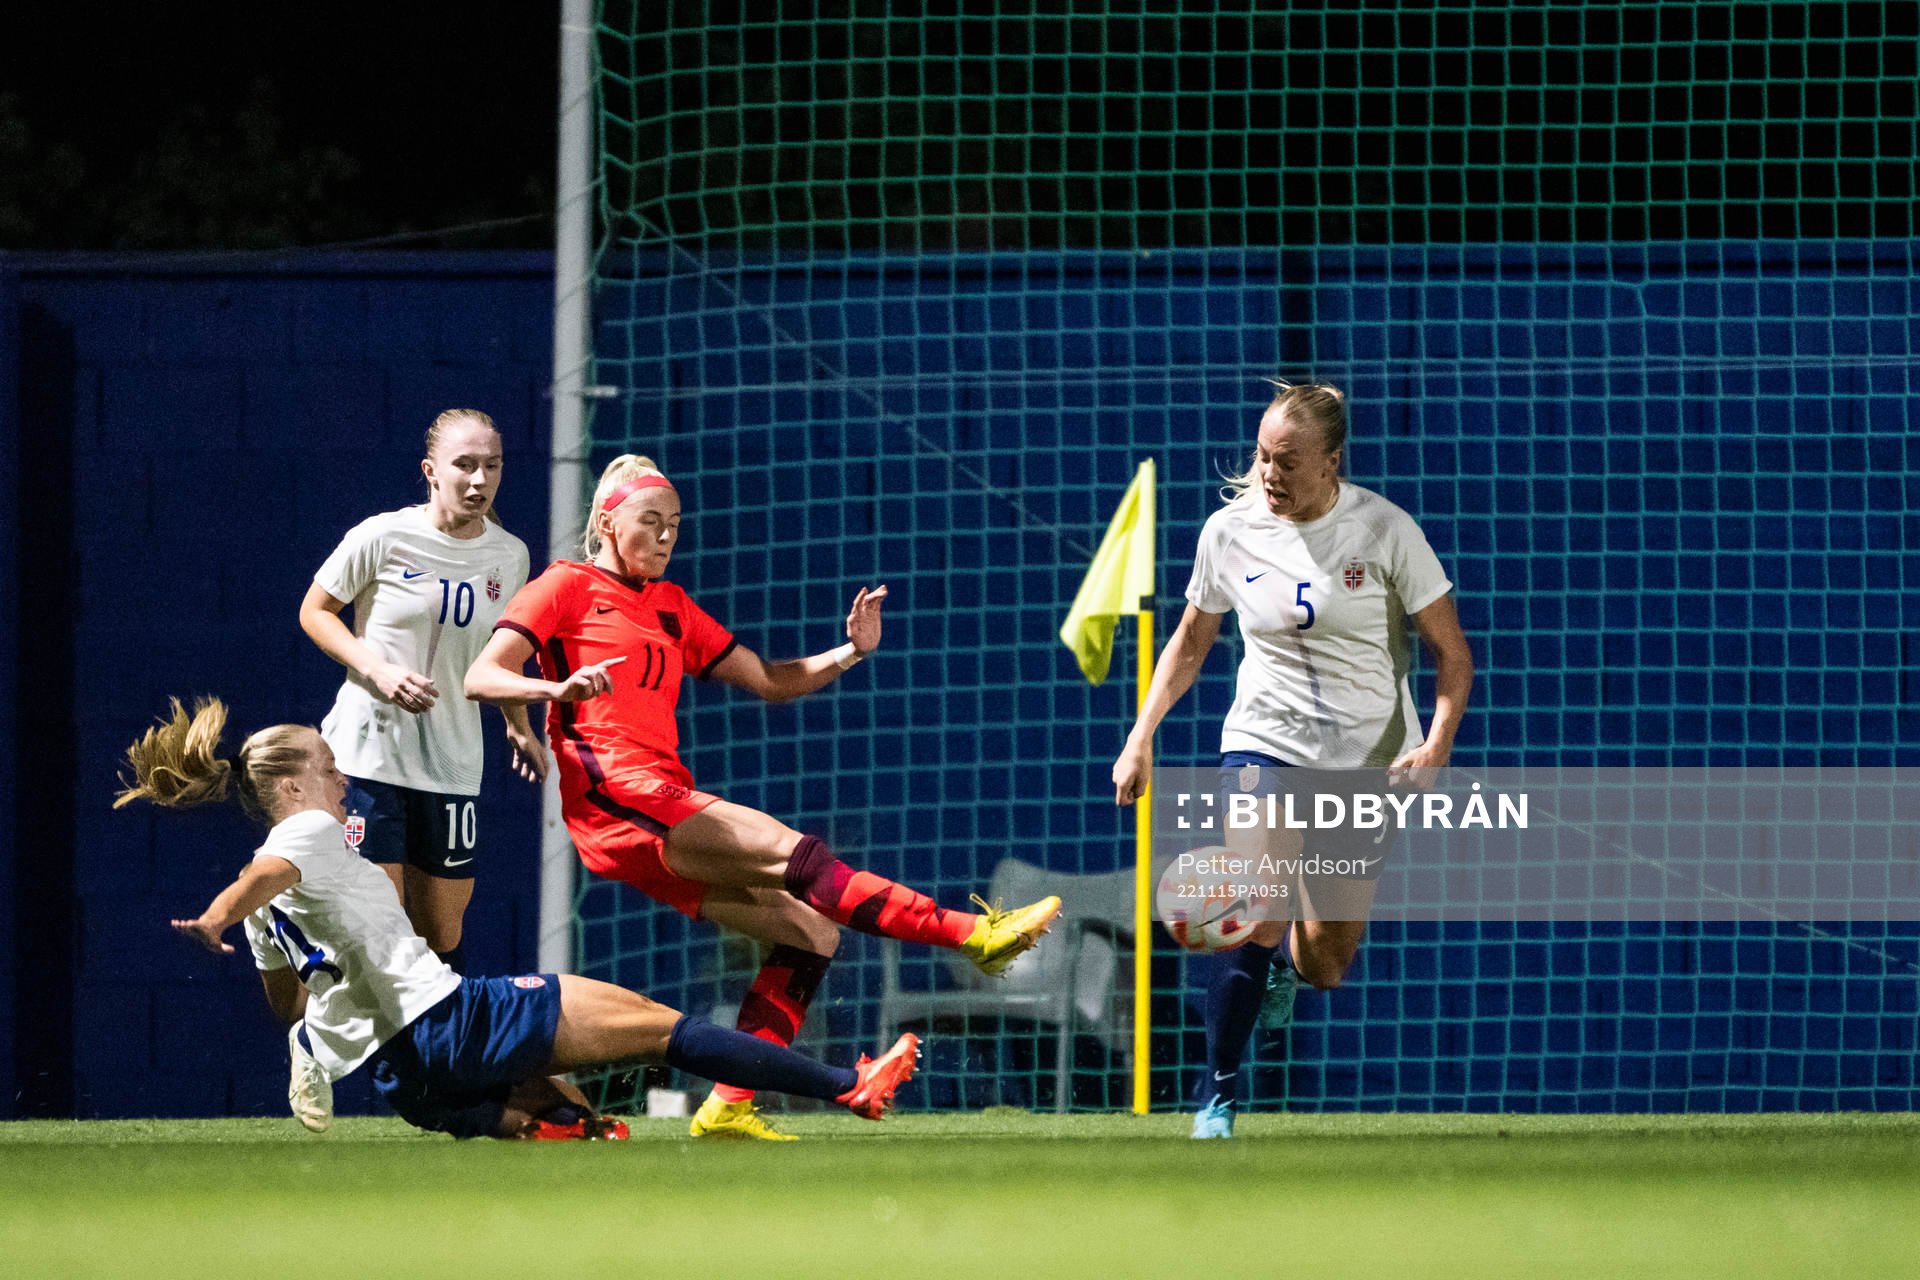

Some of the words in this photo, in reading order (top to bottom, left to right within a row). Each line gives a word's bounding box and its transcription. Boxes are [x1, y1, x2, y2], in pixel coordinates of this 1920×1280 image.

[438, 578, 475, 628] 10
[1296, 582, 1316, 630] 5
[637, 642, 665, 691] 11
[446, 801, 477, 850] 10
